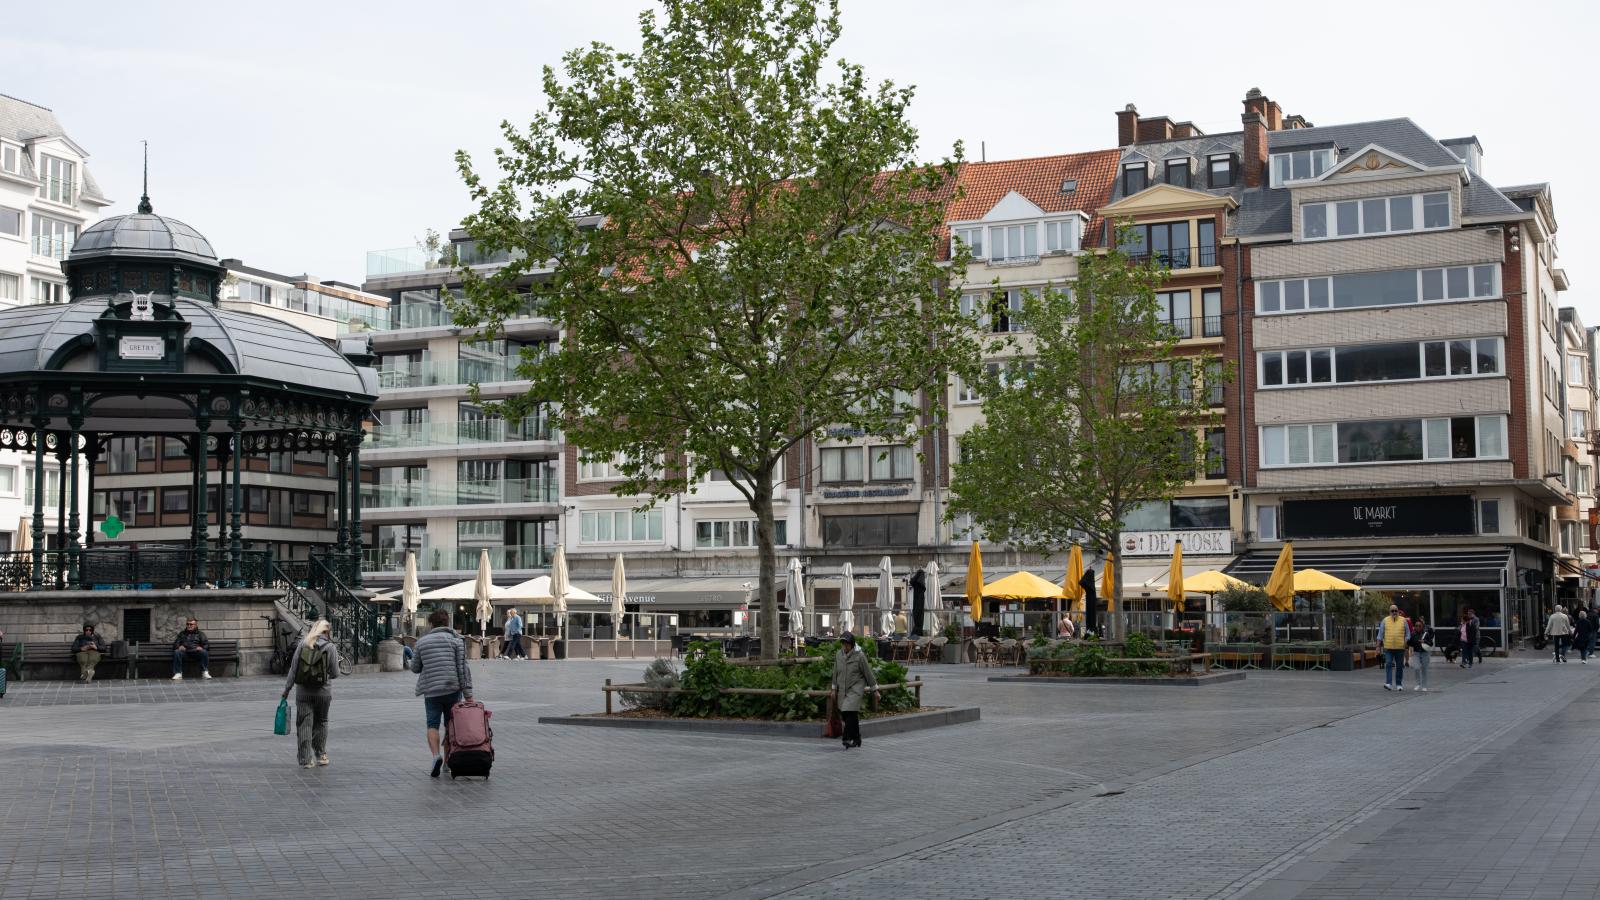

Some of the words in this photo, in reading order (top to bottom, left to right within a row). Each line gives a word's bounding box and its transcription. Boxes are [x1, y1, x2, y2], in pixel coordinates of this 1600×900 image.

[1353, 506, 1364, 520] DE
[1365, 505, 1397, 520] MARKT
[1148, 534, 1170, 552] DE
[1174, 532, 1225, 552] KIOSK
[623, 593, 656, 603] Avenue
